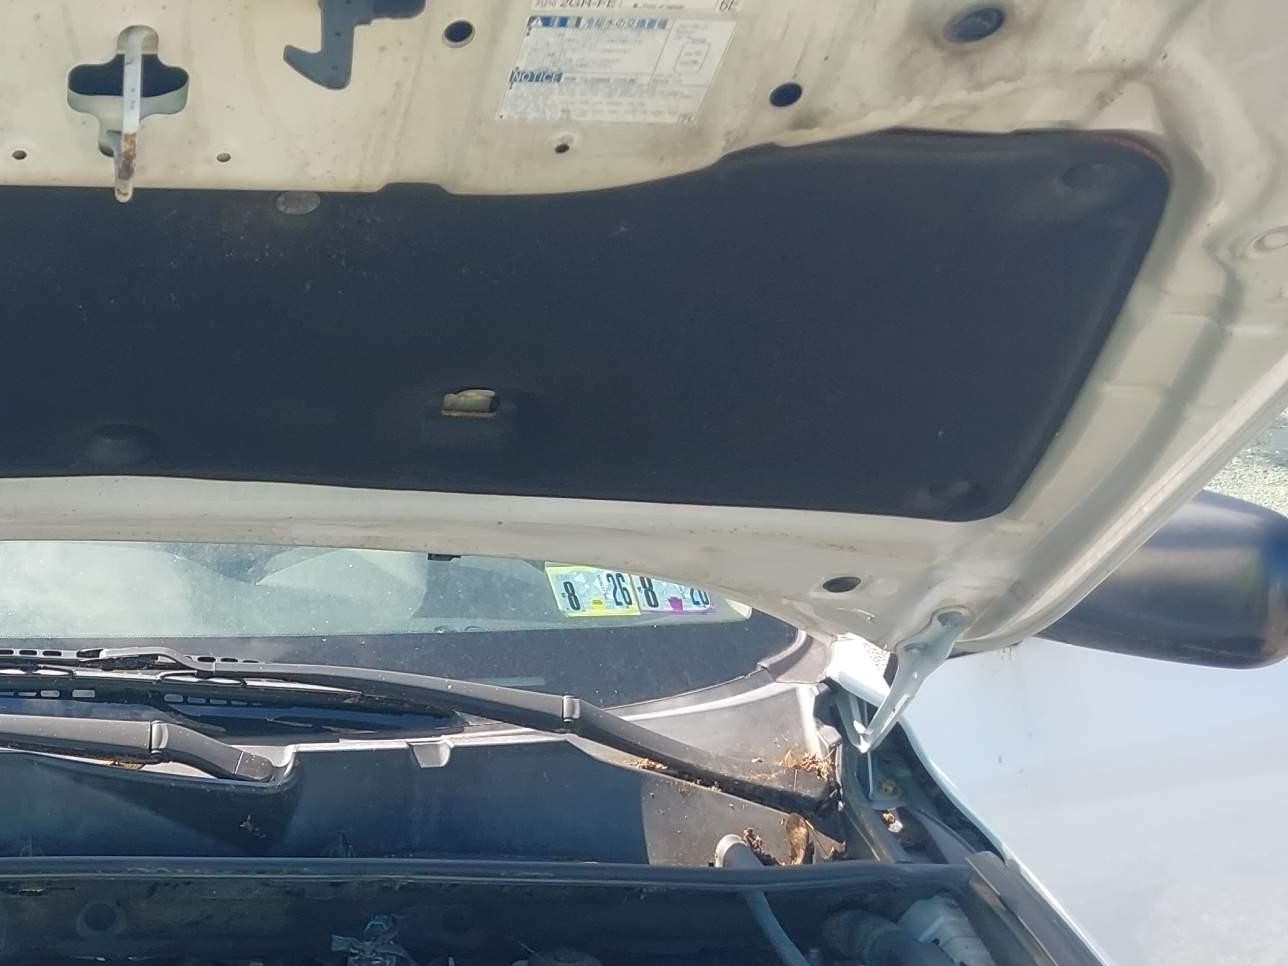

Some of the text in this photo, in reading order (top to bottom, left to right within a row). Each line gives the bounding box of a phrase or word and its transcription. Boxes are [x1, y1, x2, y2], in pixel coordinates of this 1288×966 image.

[512, 72, 560, 82] NOTICE
[563, 581, 581, 610] 8
[606, 572, 633, 606] 26
